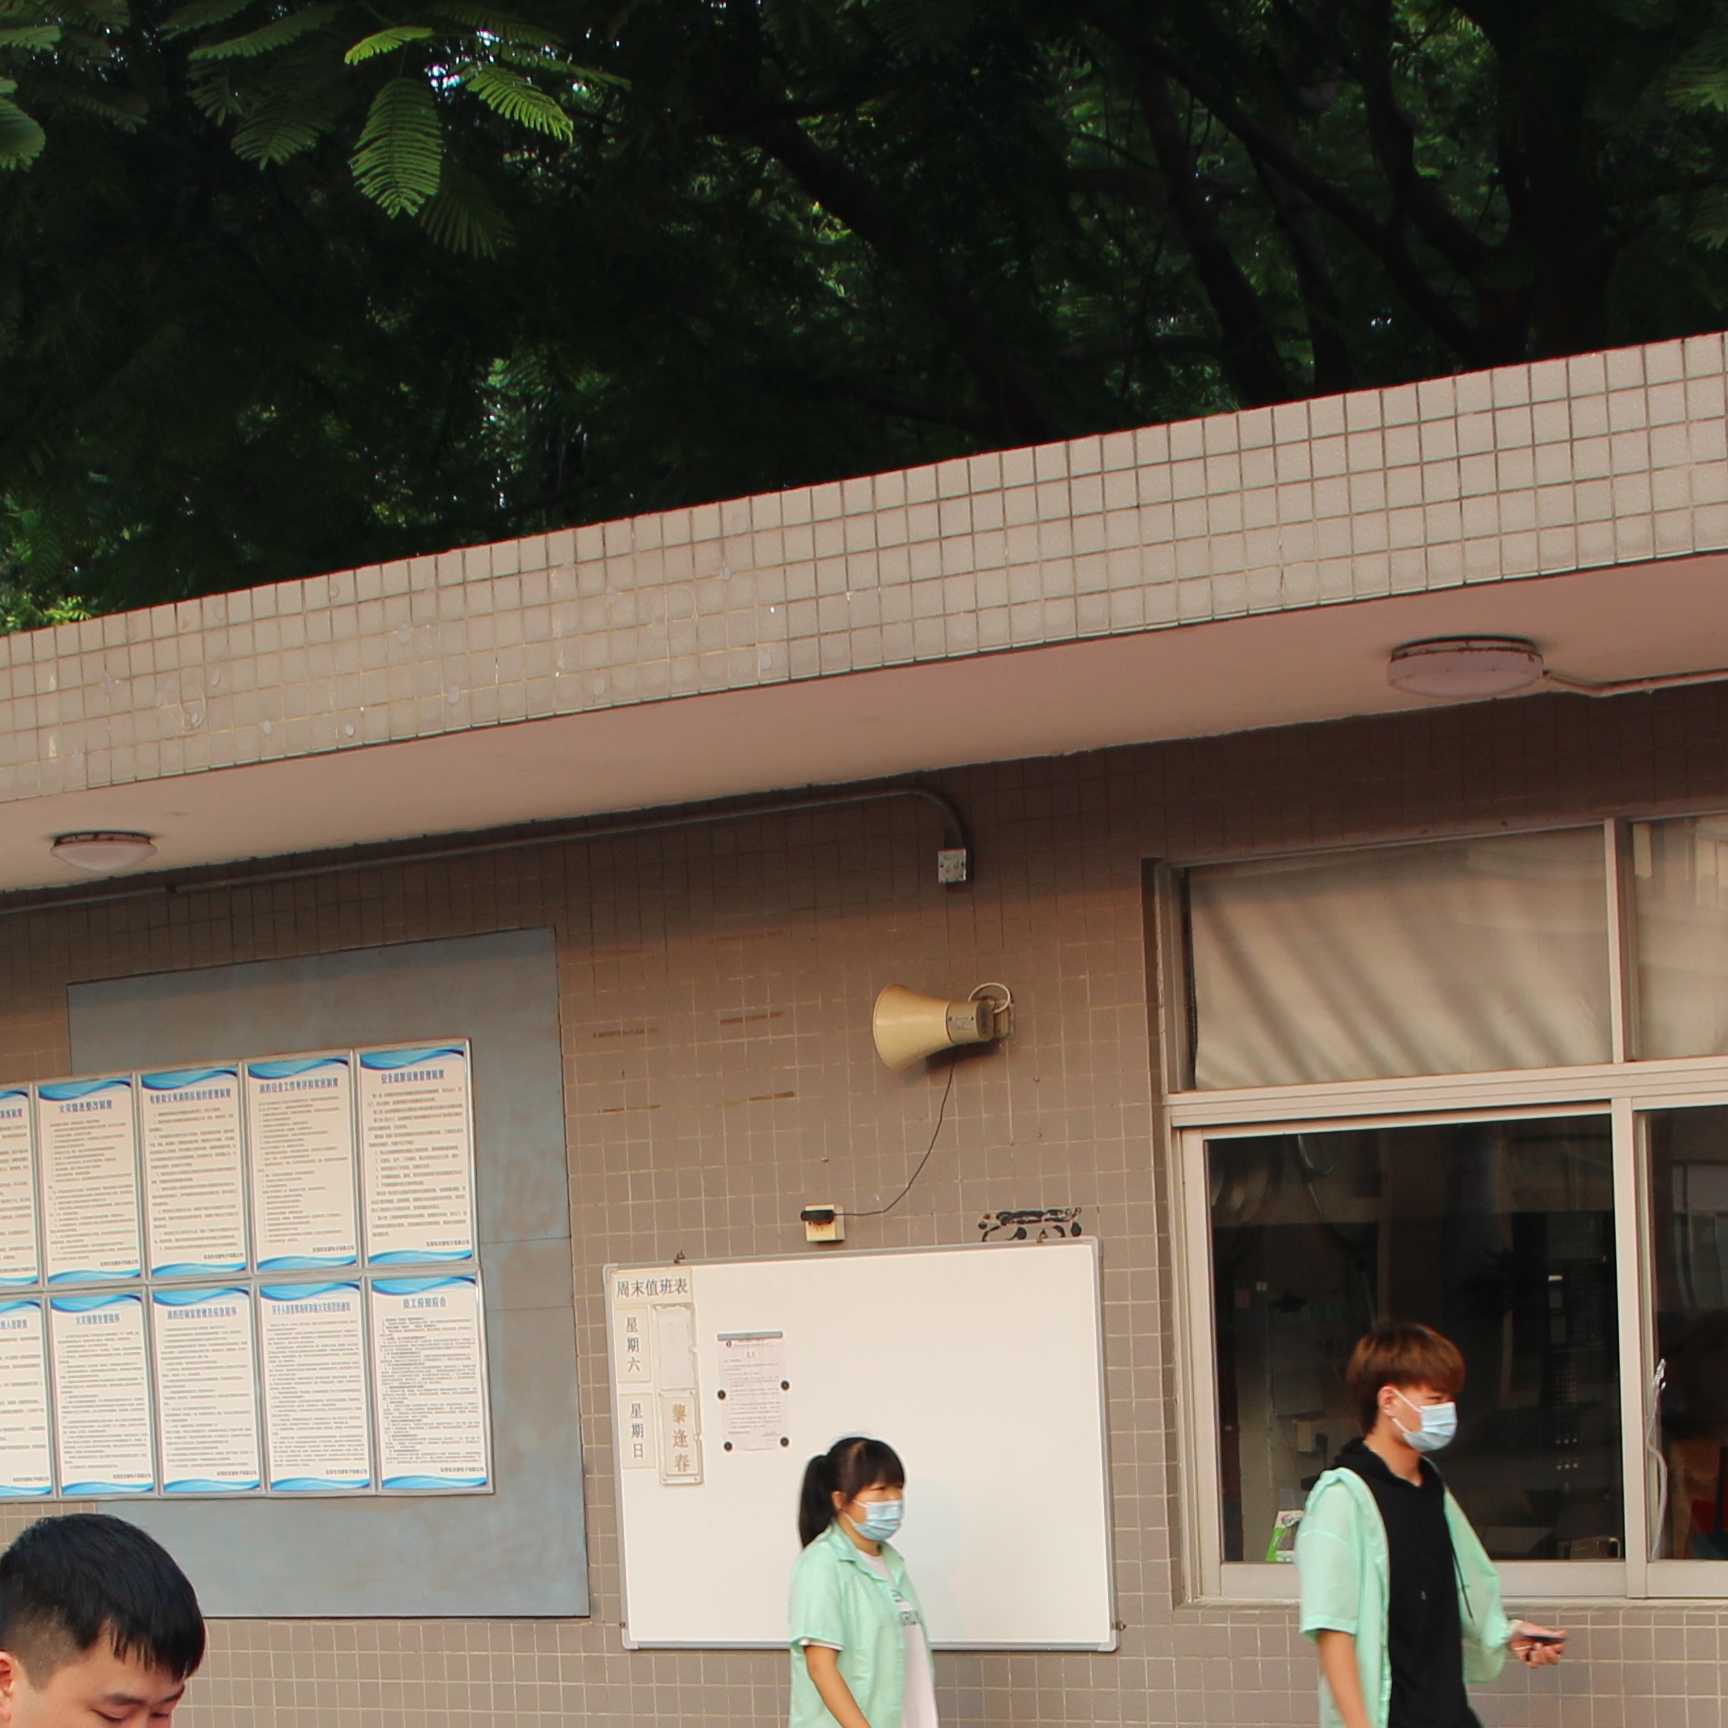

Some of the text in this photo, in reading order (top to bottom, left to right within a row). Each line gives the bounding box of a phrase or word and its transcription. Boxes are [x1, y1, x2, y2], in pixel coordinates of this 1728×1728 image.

[616, 1277, 689, 1298] 周末值班表
[626, 1316, 640, 1373] 星期六
[630, 1403, 644, 1459] 星期日
